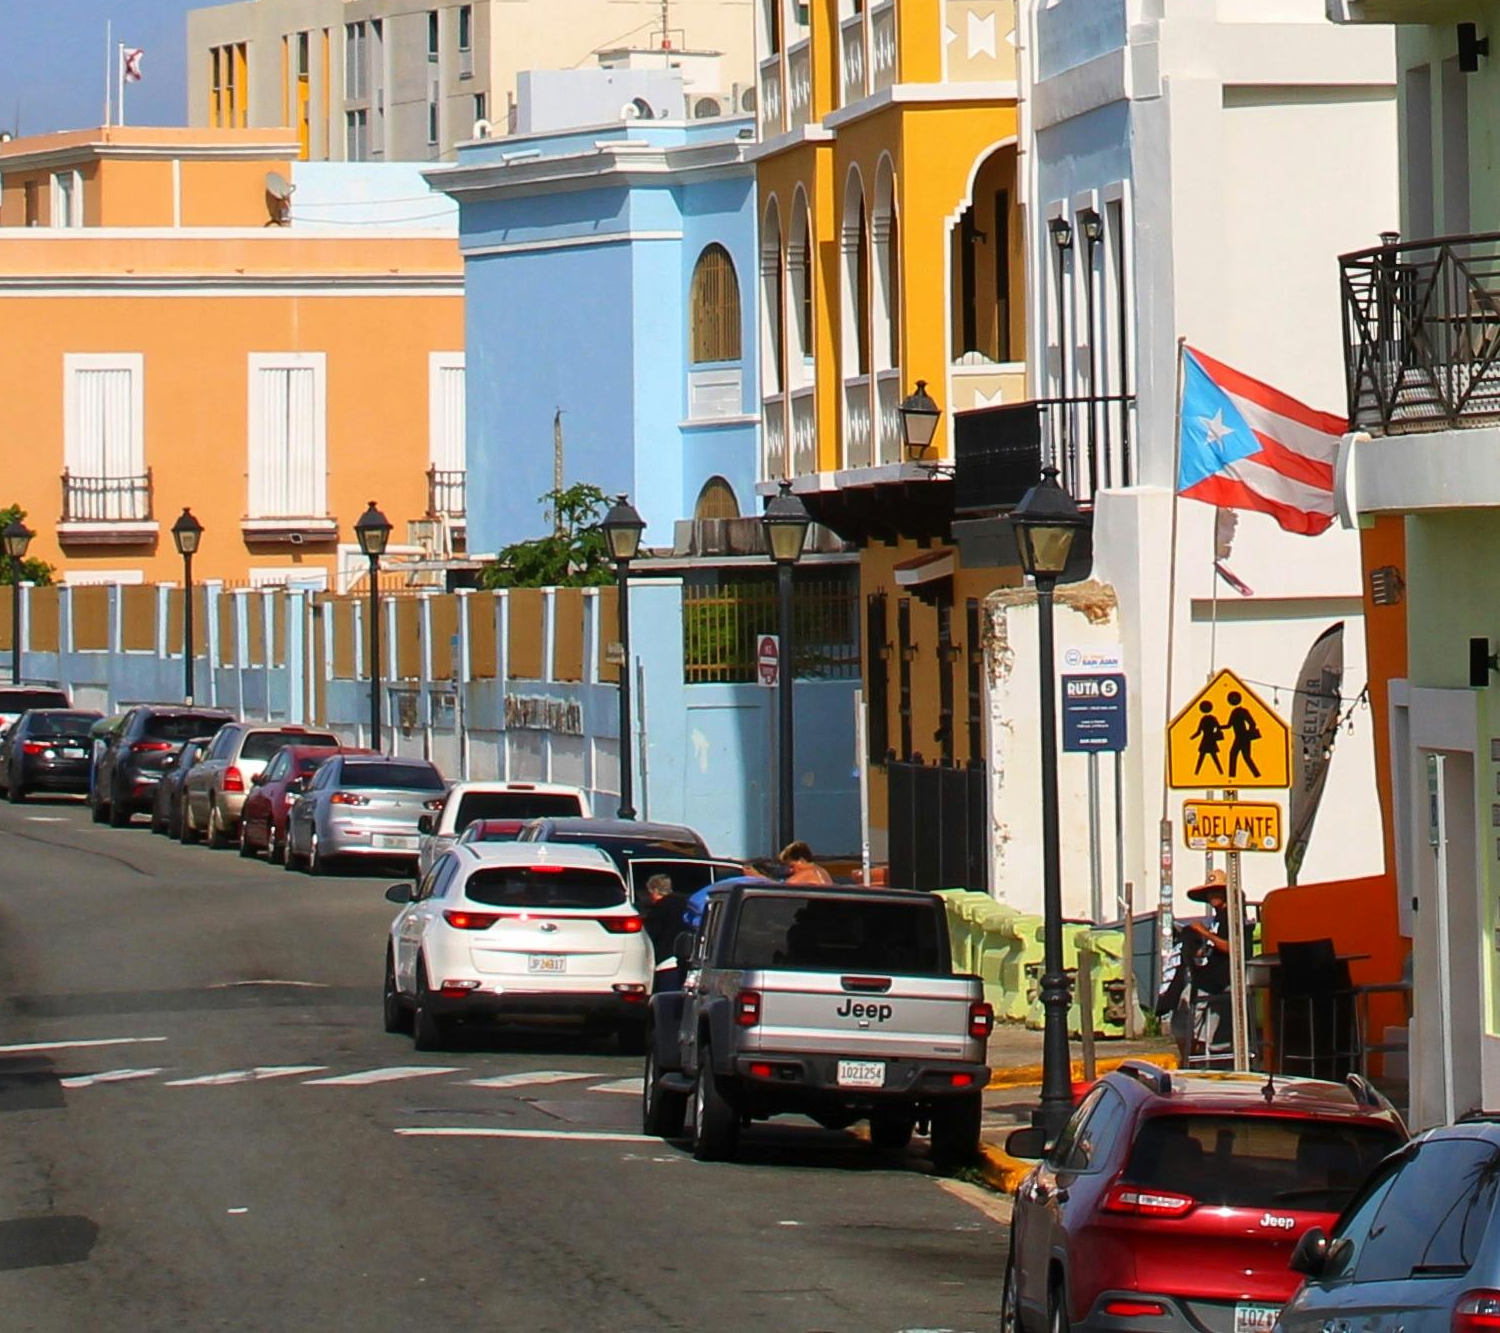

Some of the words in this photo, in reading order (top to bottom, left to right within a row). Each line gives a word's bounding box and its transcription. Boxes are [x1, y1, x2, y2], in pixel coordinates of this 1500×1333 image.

[1067, 681, 1099, 696] RUTA
[1303, 678, 1321, 748] SELTZER
[1191, 815, 1274, 838] ADELANTE
[836, 998, 892, 1022] Jeep
[840, 1066, 882, 1080] 1021254
[1260, 1212, 1295, 1230] Jeep
